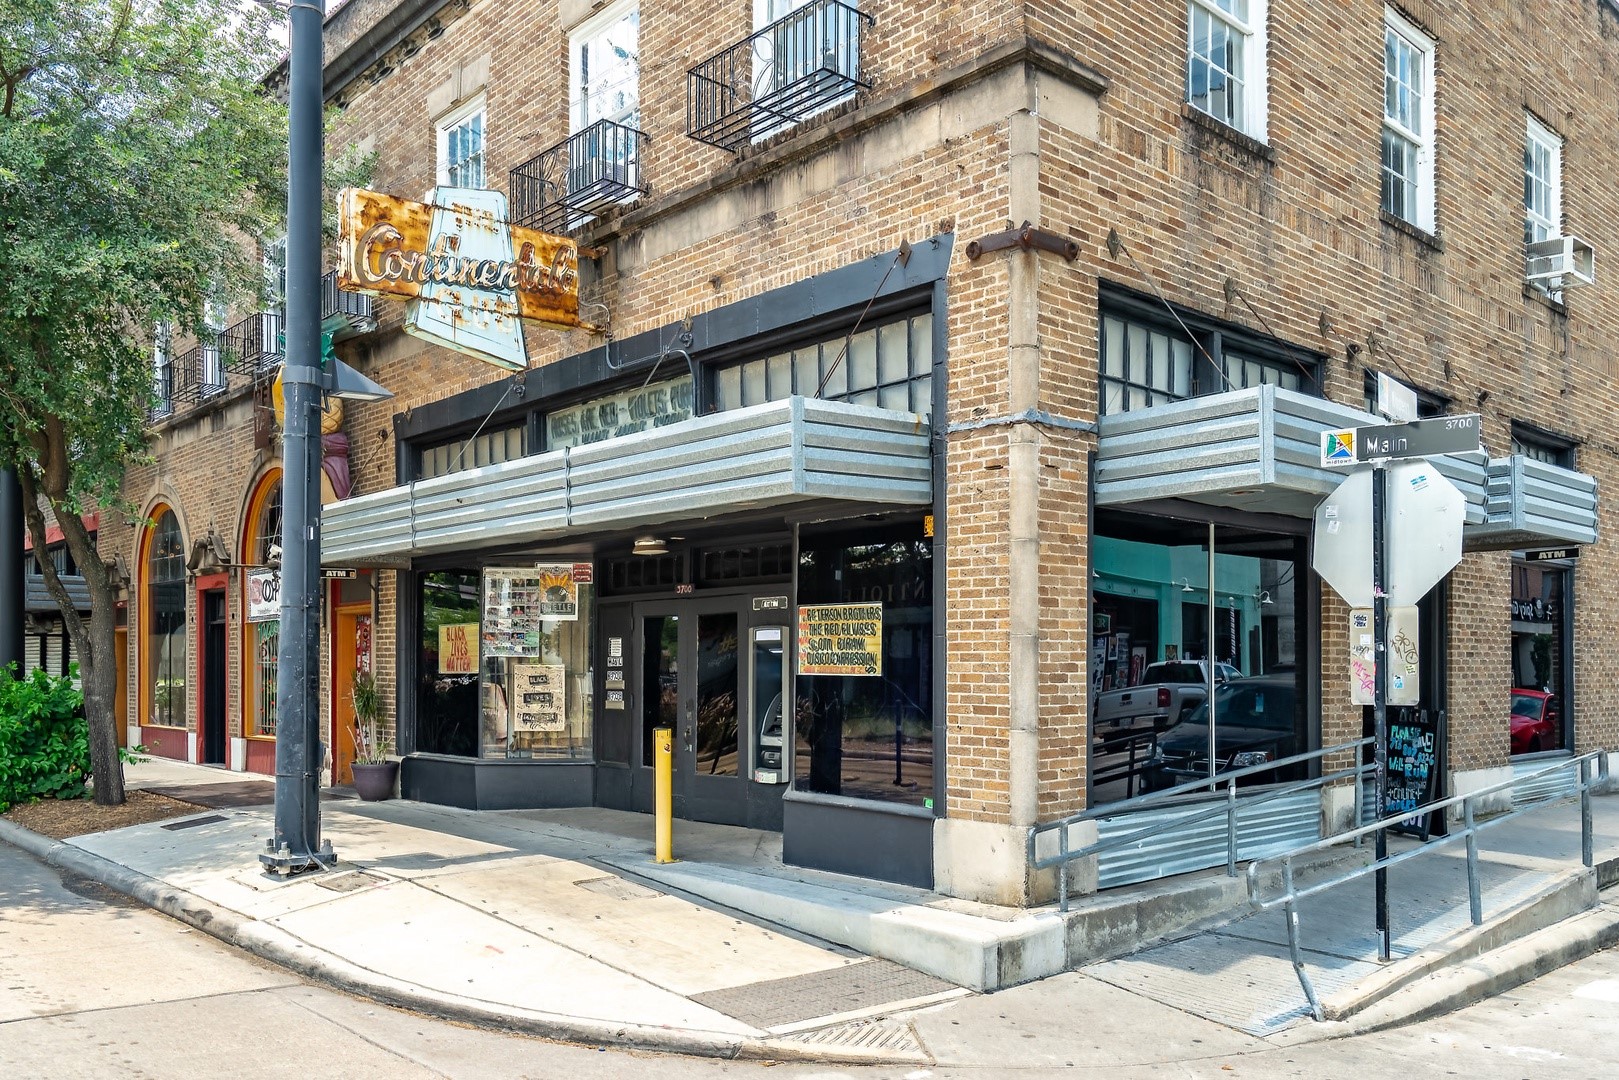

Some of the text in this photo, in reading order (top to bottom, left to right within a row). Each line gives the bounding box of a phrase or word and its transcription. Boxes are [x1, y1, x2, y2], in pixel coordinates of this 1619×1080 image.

[355, 222, 577, 292] Continental
[1446, 419, 1473, 430] 3700
[1366, 438, 1407, 454] Main
[1538, 550, 1566, 560] ATM
[326, 570, 346, 578] ATM
[676, 585, 692, 594] 3700
[447, 626, 465, 641] BLACK
[809, 624, 822, 636] THE
[451, 641, 468, 656] LIVES
[446, 656, 471, 672] MATTER
